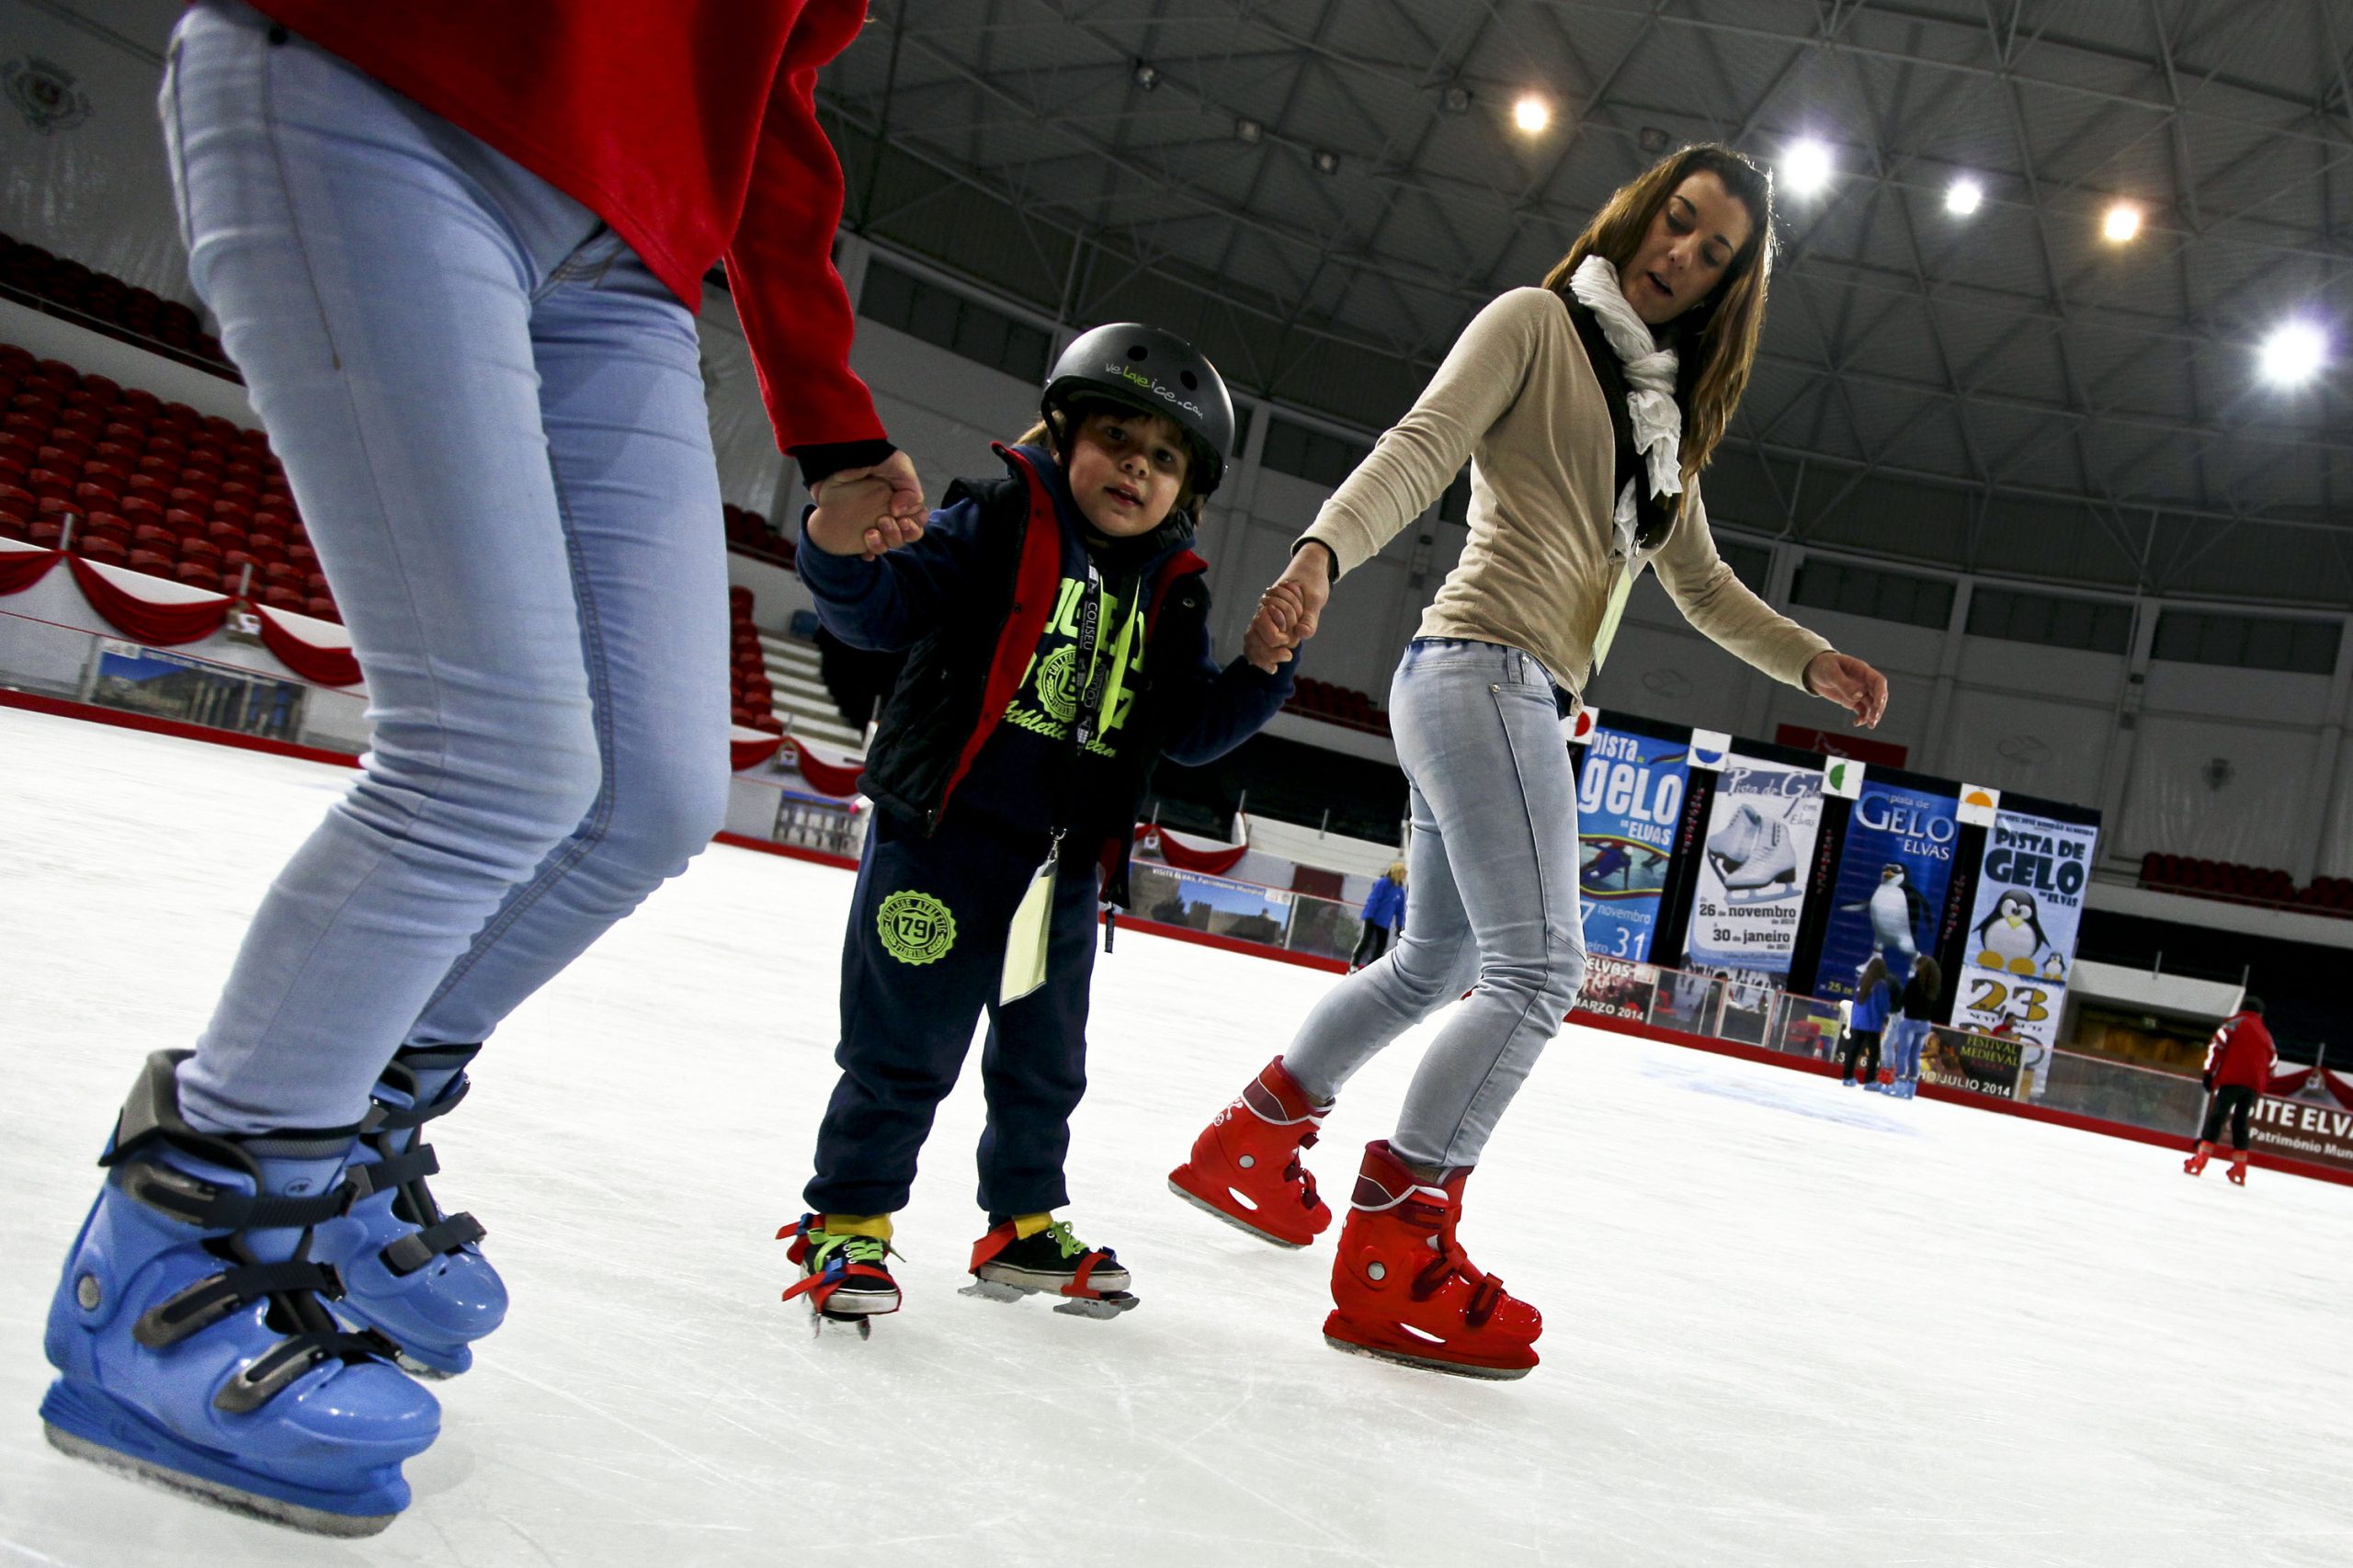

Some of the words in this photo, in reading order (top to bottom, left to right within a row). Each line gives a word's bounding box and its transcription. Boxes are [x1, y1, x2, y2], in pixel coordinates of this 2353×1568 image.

[1083, 602, 1098, 651] COLISEU
[1721, 766, 1758, 797] Pista
[1761, 778, 1780, 797] de
[1889, 793, 1915, 806] pista
[1915, 799, 1930, 810] de
[1855, 790, 1955, 843] GELO
[1628, 821, 1673, 846] ELVAS
[1995, 827, 2054, 856] PISTA
[2058, 839, 2086, 860] DE
[1904, 838, 1950, 860] ELVAS
[1985, 847, 2085, 896] GELO
[2047, 892, 2078, 907] ELVAS
[1597, 903, 1652, 926] novembro
[1699, 903, 1717, 917] 26
[1728, 904, 1797, 919] novembro
[901, 915, 928, 939] 79
[1712, 928, 1732, 942] 30
[1743, 928, 1791, 945] janeiro
[1610, 926, 1646, 962] 31
[1586, 957, 1631, 978] ELVAS
[1827, 980, 1843, 993] 25
[1966, 978, 2050, 1022] 23
[1617, 1006, 1644, 1021] 2014
[1966, 1035, 2018, 1055] FESTIVAL
[1960, 1046, 2019, 1067] MEDIEVAL
[1981, 1081, 2011, 1098] 2014
[2249, 1127, 2323, 1153] Património
